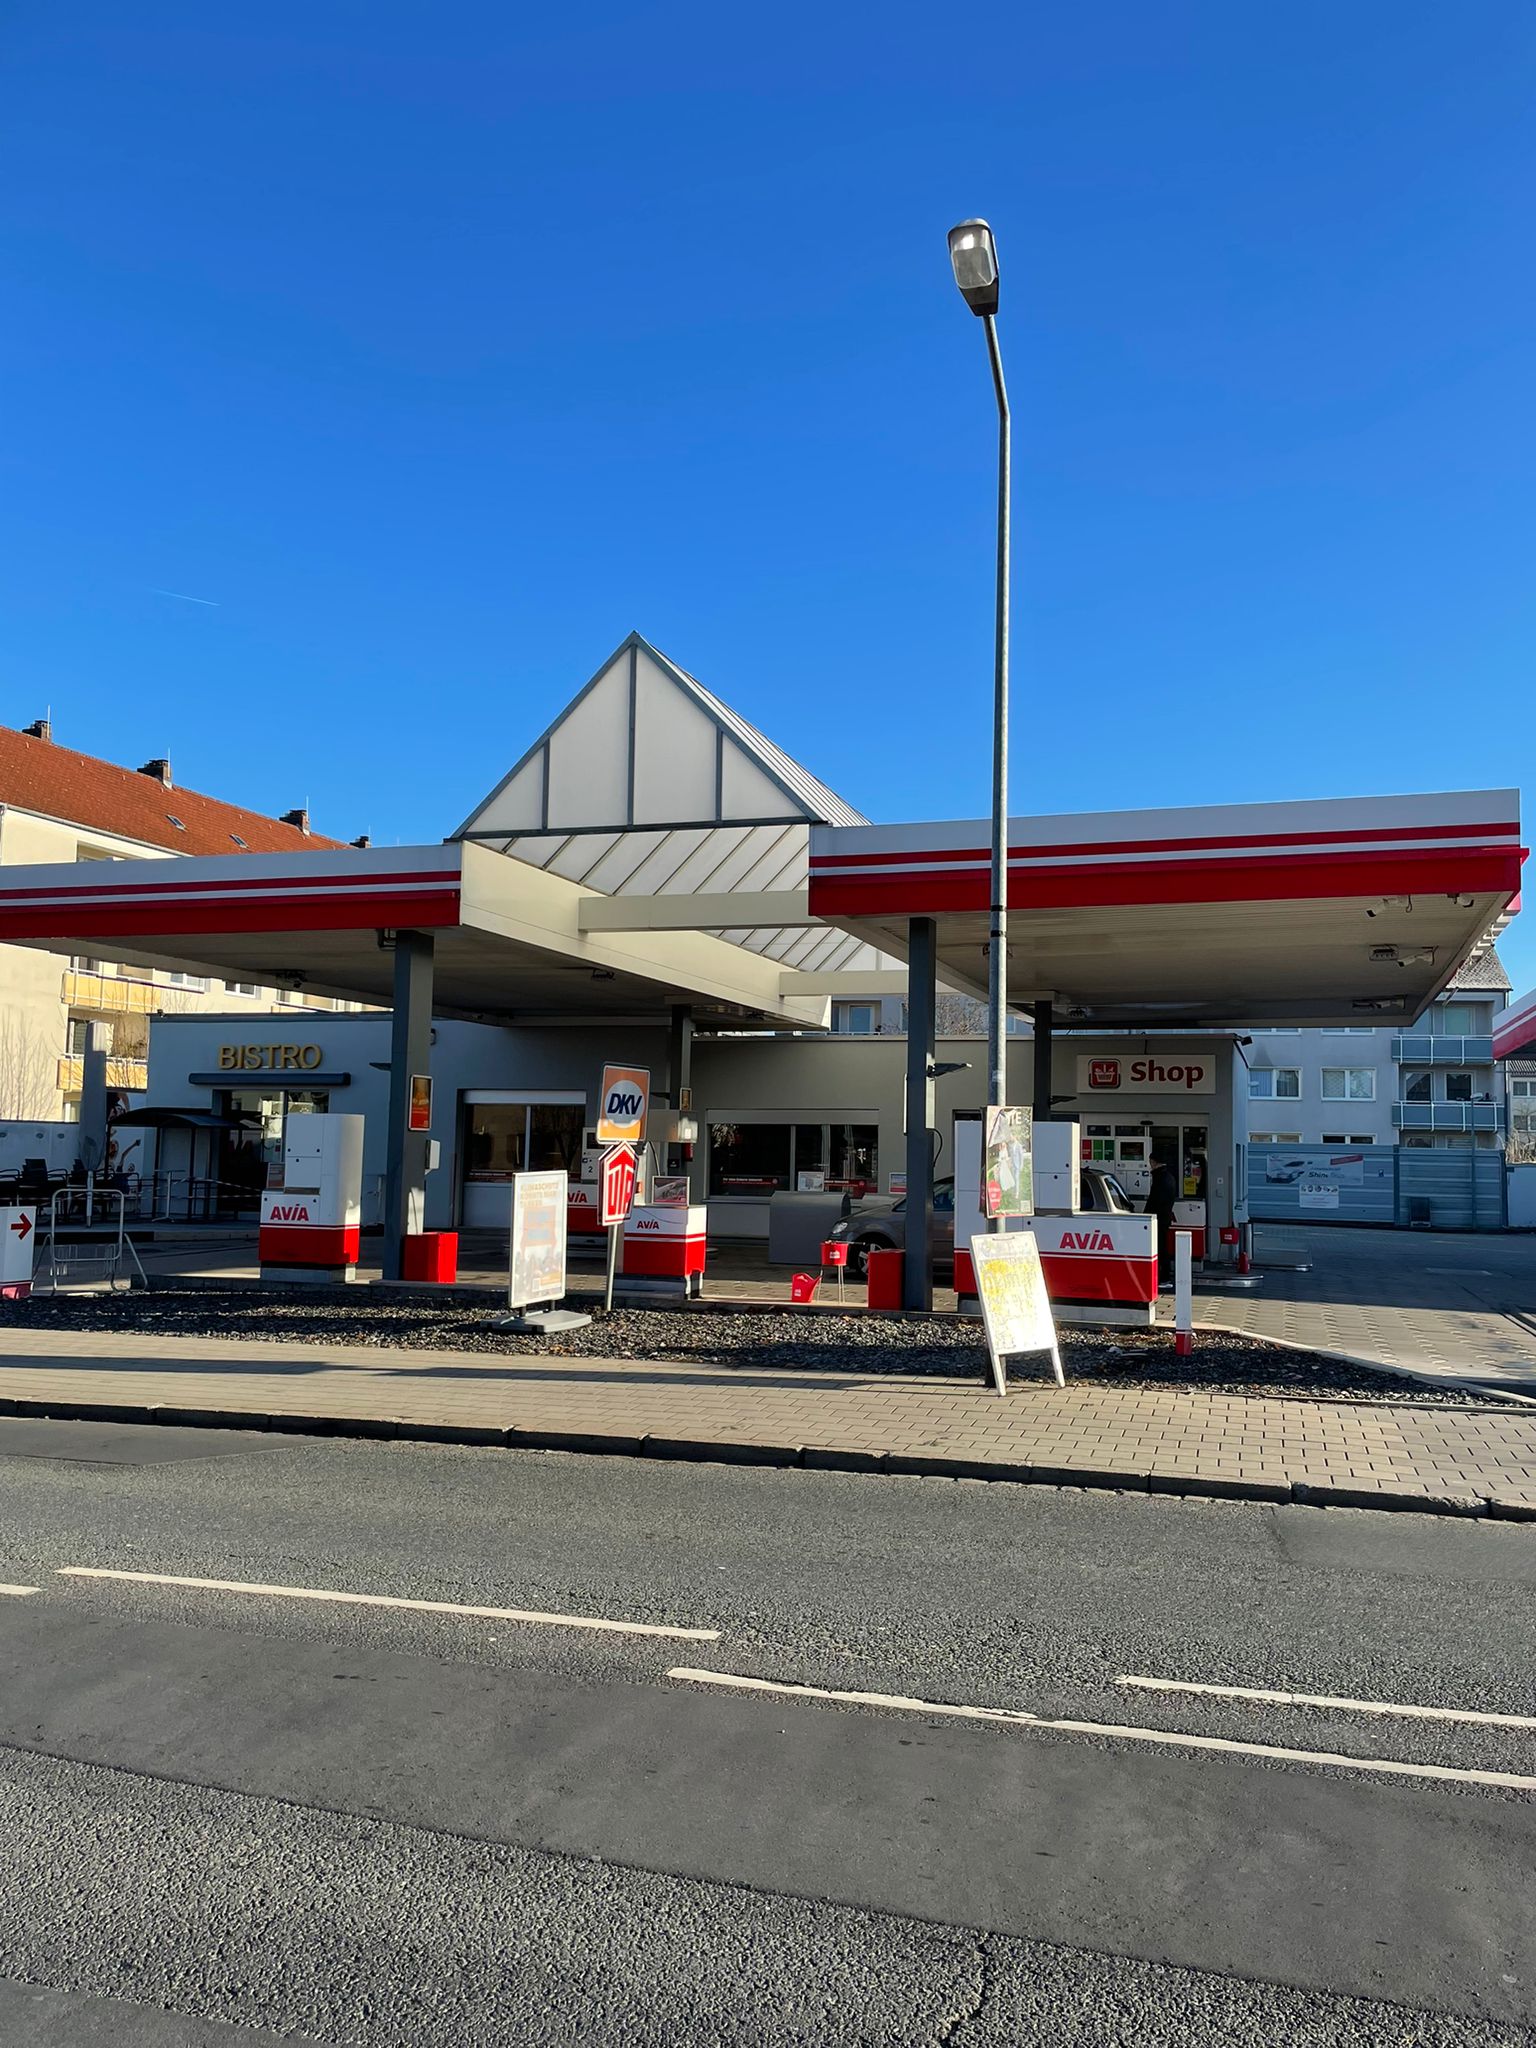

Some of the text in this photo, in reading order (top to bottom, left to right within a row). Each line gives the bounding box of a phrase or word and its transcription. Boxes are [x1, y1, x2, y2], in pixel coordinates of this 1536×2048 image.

[219, 1044, 323, 1069] BISTRO
[1130, 1059, 1204, 1088] Shop
[607, 1093, 643, 1115] DKV
[1134, 1179, 1140, 1187] 4
[270, 1203, 309, 1222] AVIA
[636, 1218, 660, 1231] AVIA
[1060, 1229, 1114, 1252] AVIA
